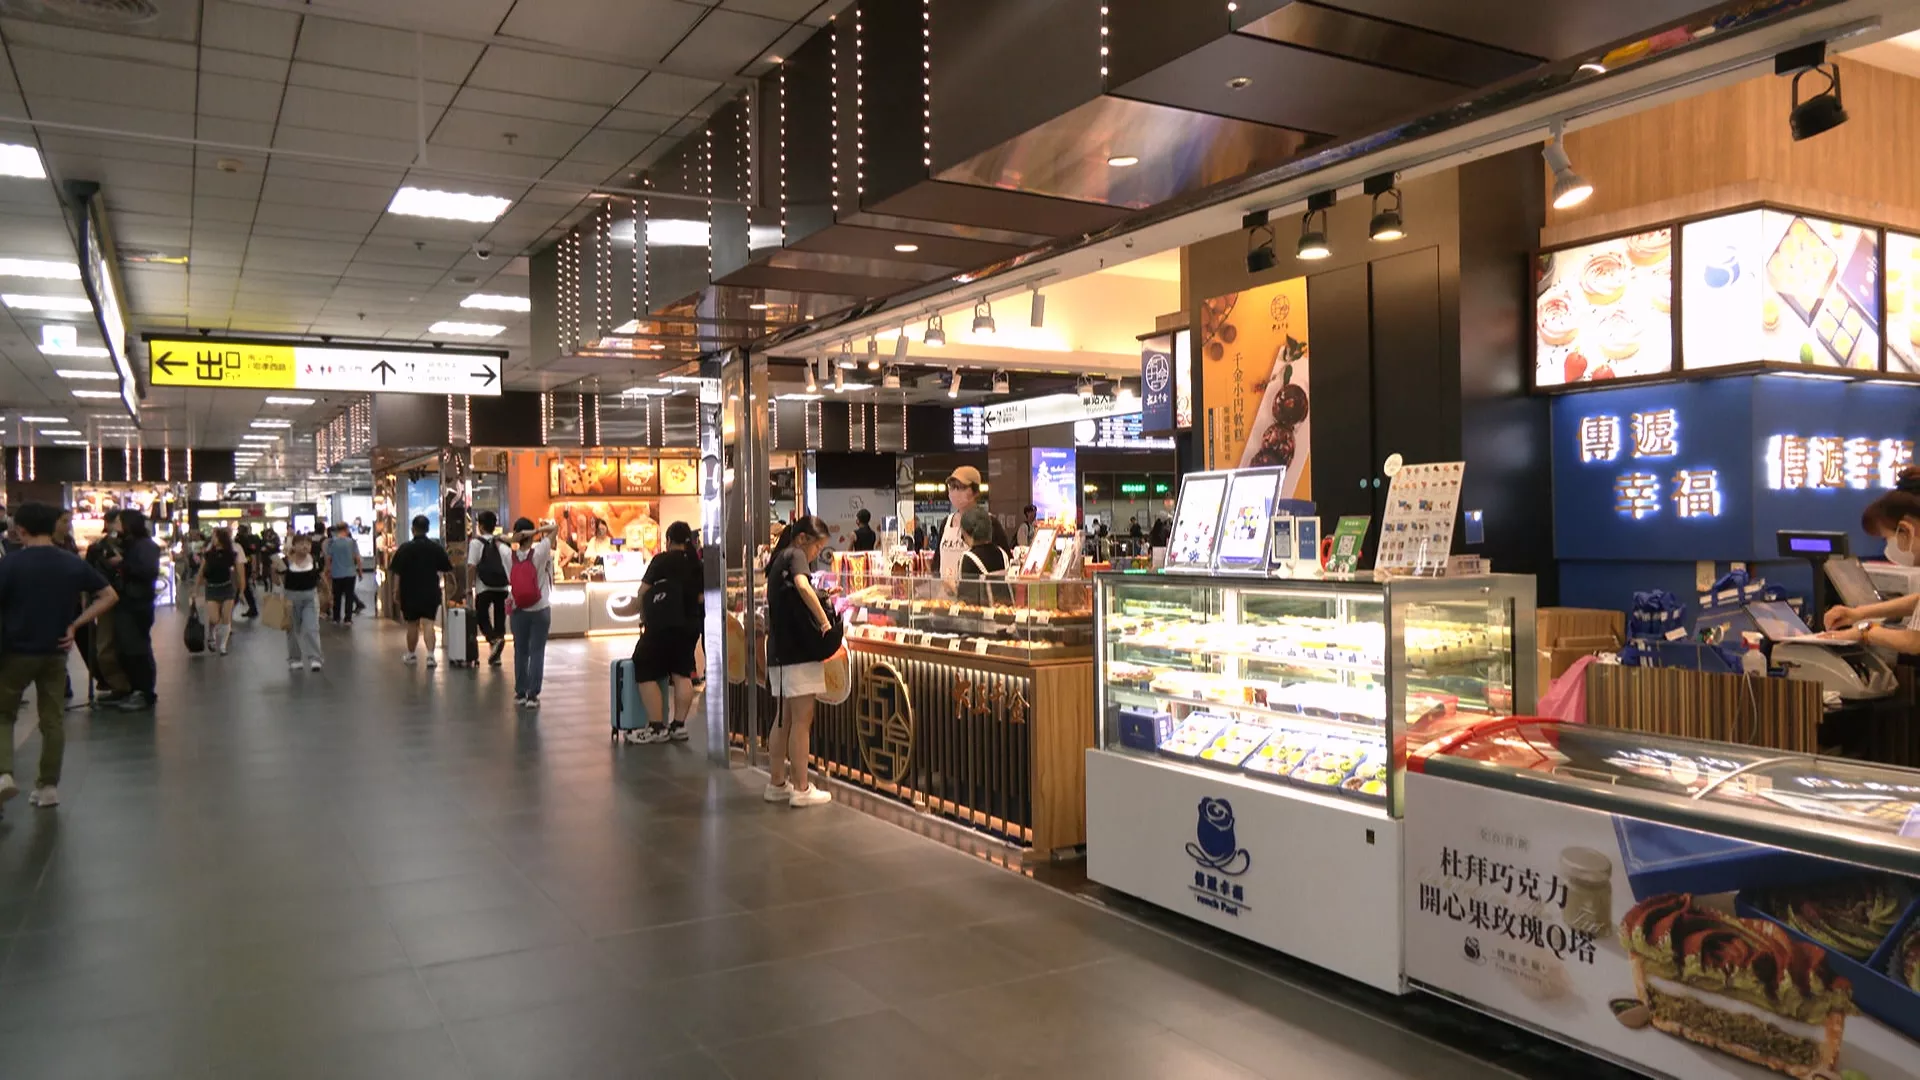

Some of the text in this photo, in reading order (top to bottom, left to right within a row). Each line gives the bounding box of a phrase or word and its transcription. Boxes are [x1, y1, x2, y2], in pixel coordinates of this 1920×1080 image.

[196, 350, 241, 380] 出口
[1576, 408, 1679, 462] 傳遞
[1766, 434, 1916, 490] 傳遞幸福
[1613, 469, 1721, 520] 幸福
[1440, 846, 1568, 909] 杜拜巧克力
[1419, 882, 1597, 965] 開心果玫瑰Q塔
